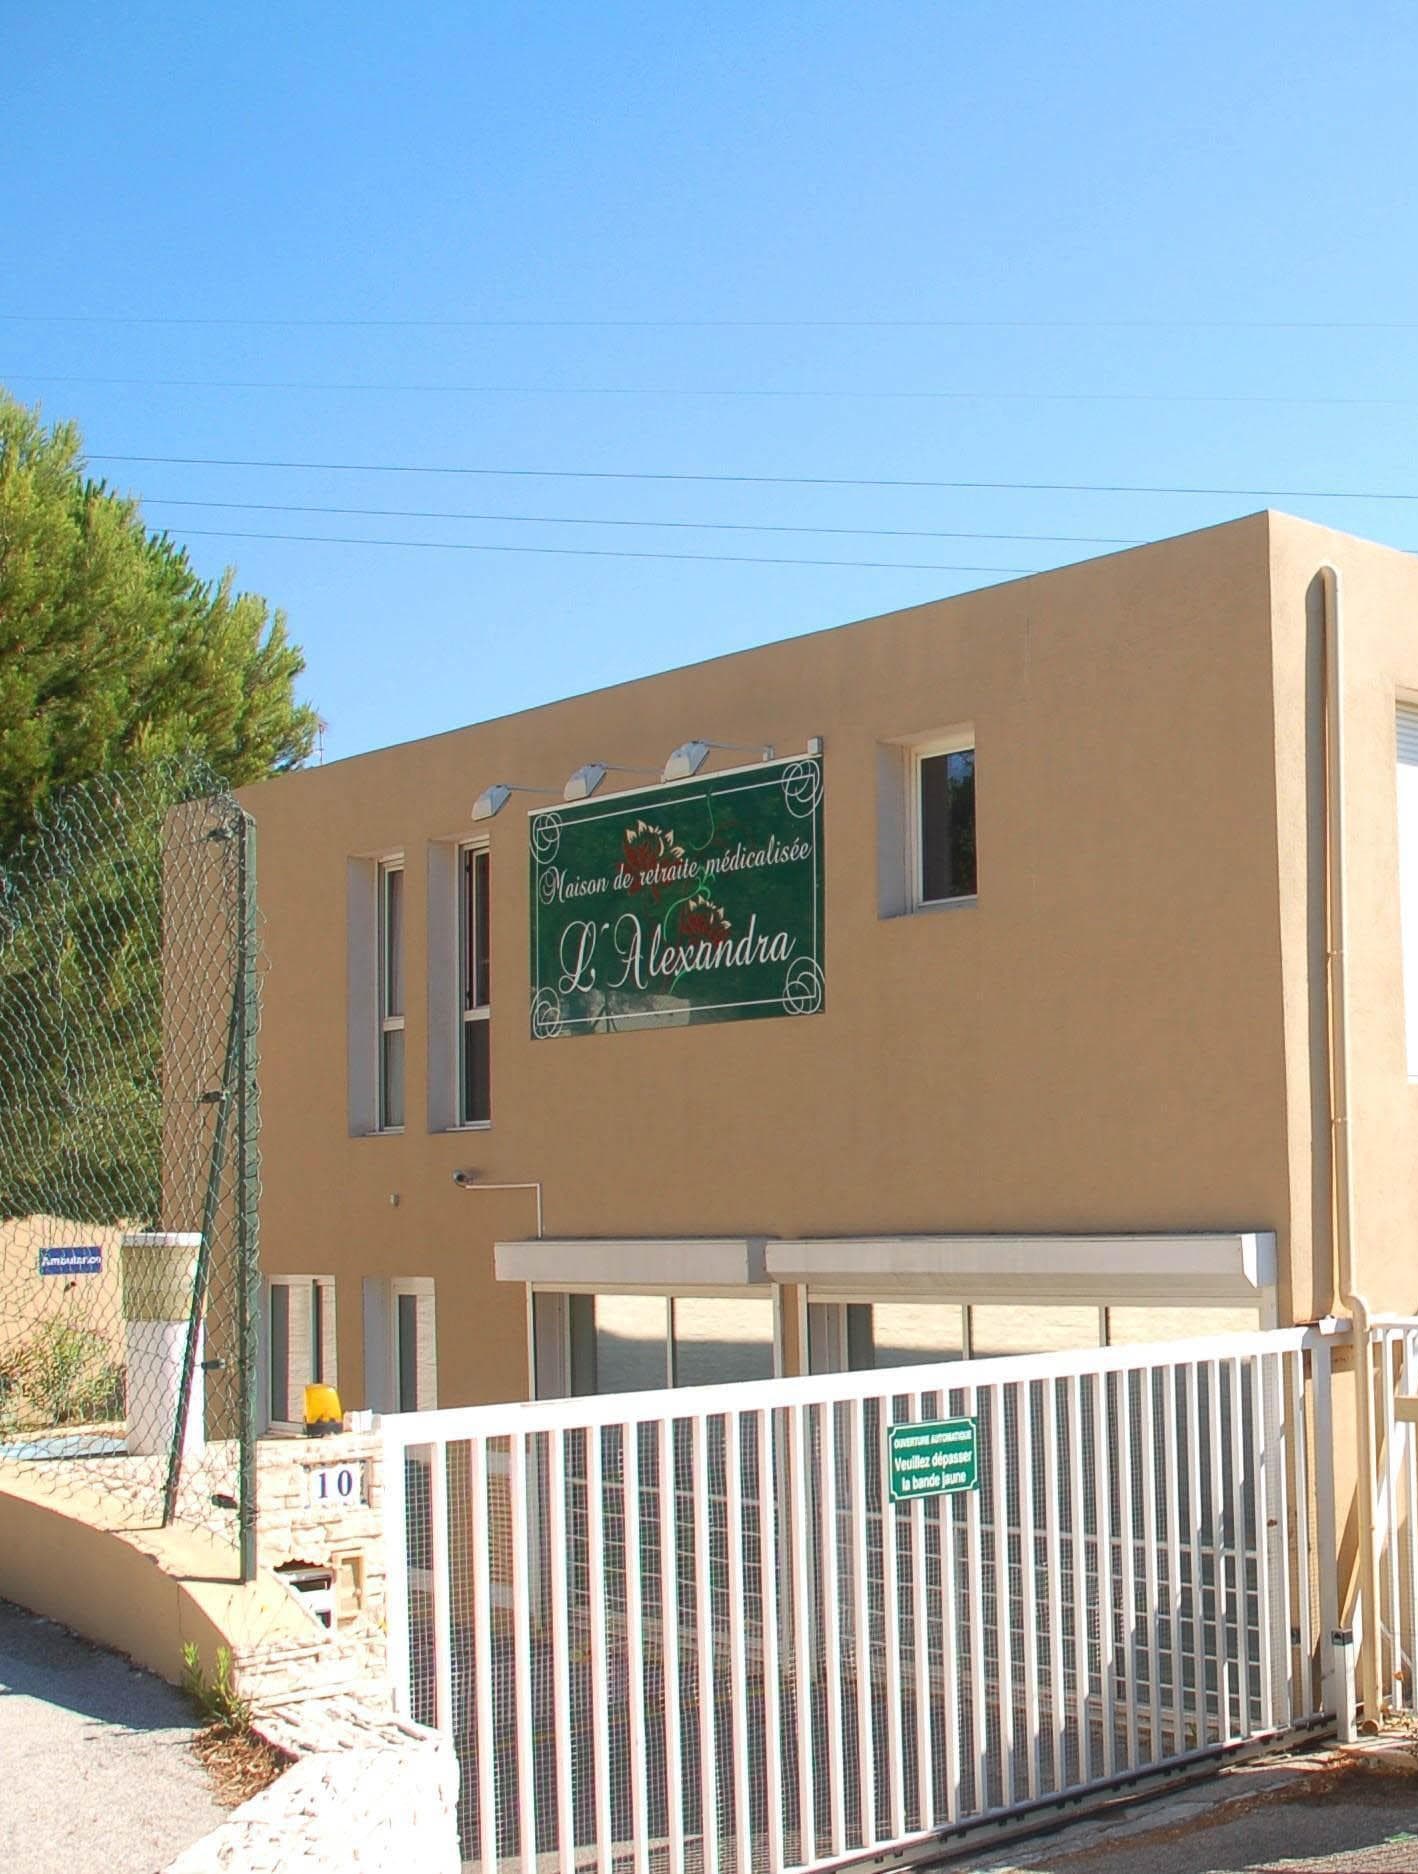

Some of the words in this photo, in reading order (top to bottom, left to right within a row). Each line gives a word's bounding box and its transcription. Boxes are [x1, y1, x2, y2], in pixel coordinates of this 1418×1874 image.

[539, 866, 609, 904] Maison
[613, 863, 633, 889] de
[639, 856, 700, 886] retraite
[705, 834, 812, 876] médicalisée
[894, 1435, 930, 1449] OUVERTURE
[931, 1430, 972, 1444] AUTOMATIQUE
[895, 1454, 930, 1472] Veuillez
[931, 1450, 972, 1469] dépasser
[318, 1470, 353, 1499] 10
[902, 1476, 911, 1491] la
[912, 1473, 941, 1490] bande
[942, 1471, 967, 1489] jaune
